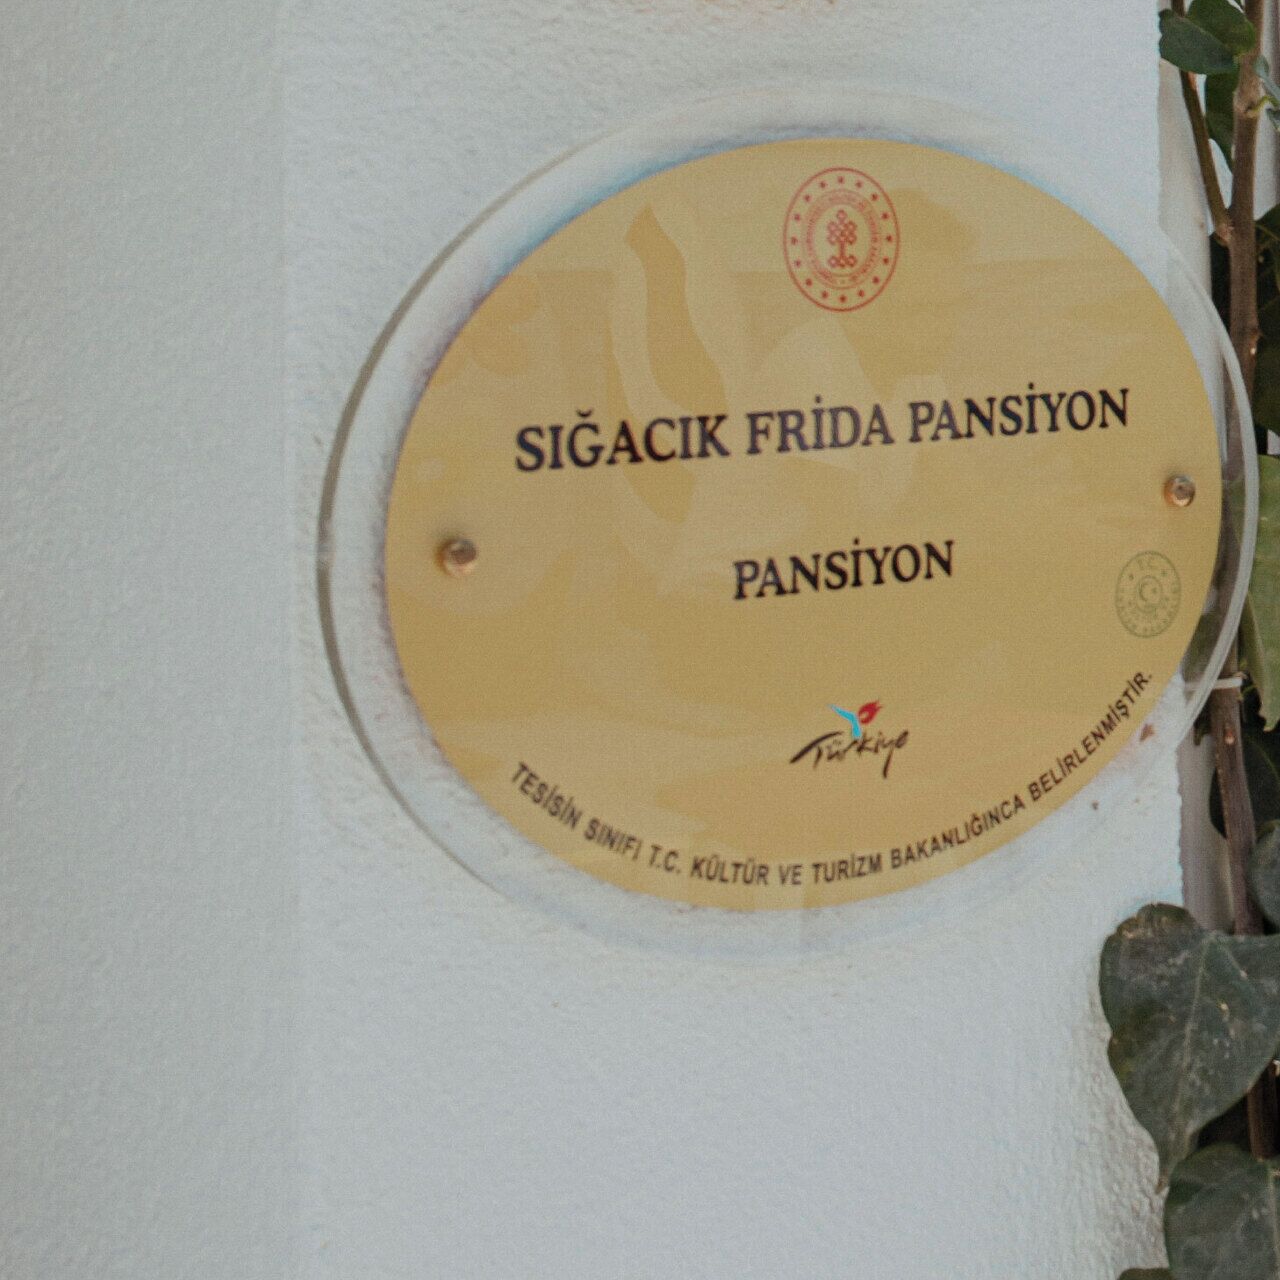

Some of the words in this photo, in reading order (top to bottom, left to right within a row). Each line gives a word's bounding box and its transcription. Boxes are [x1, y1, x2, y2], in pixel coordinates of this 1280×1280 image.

[514, 409, 731, 472] SIĞACIK
[745, 395, 895, 456] FRİDA
[908, 381, 1130, 444] PANSİYON
[732, 536, 955, 600] PANSİYON
[789, 730, 909, 779] Türkiye
[650, 844, 682, 877] T.C.
[690, 854, 770, 886] KÜLTÜR
[778, 864, 804, 886] VE
[811, 853, 883, 885] TURİZM
[890, 794, 1026, 870] BAKANLIĞINCA
